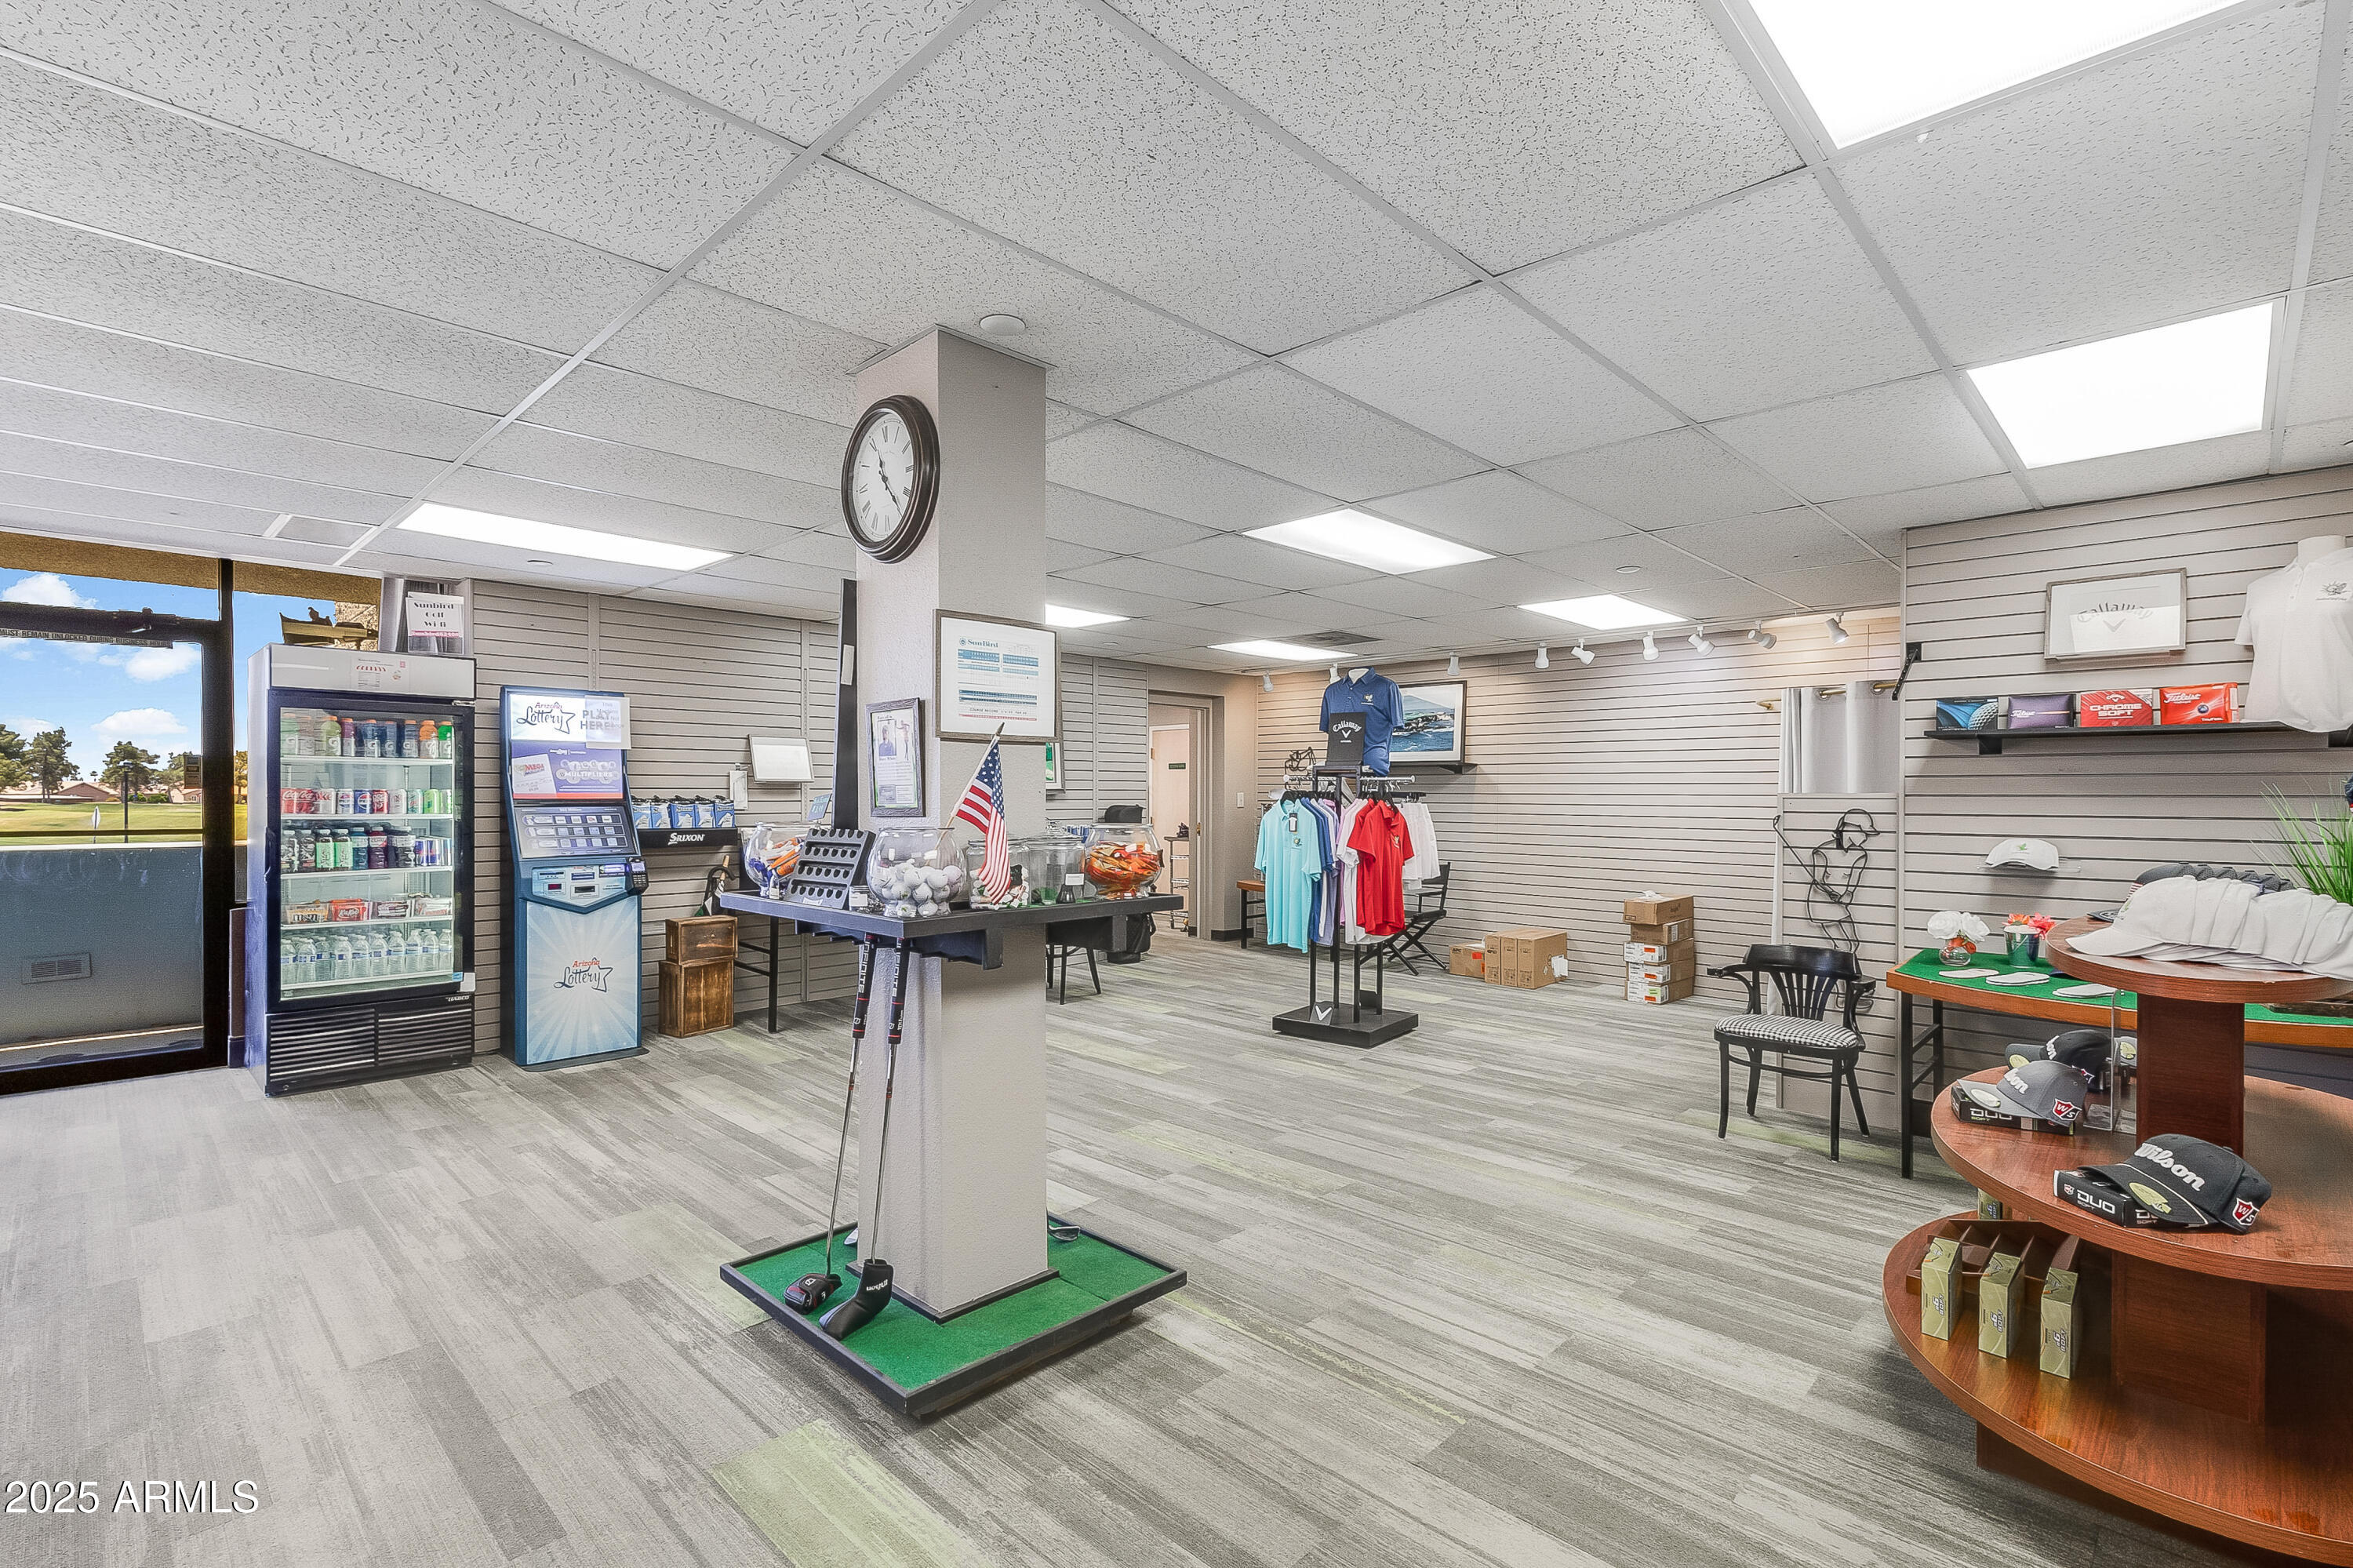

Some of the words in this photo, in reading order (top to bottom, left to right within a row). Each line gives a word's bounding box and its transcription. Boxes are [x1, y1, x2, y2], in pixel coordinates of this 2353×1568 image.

[21, 630, 49, 638] REMAIN
[52, 632, 87, 641] UNLOCKED
[2163, 692, 2202, 704] Titleist
[535, 701, 563, 710] Arizona
[2089, 703, 2143, 711] CHROME
[516, 706, 563, 730] Lottery
[583, 709, 610, 720] PLAY
[1332, 720, 1362, 733] Callaway
[572, 959, 600, 968] Arizona
[553, 966, 601, 989] Lottery
[2133, 1142, 2206, 1191] Wilson
[2076, 1200, 2096, 1210] SOFT
[2077, 1189, 2116, 1213] DUO
